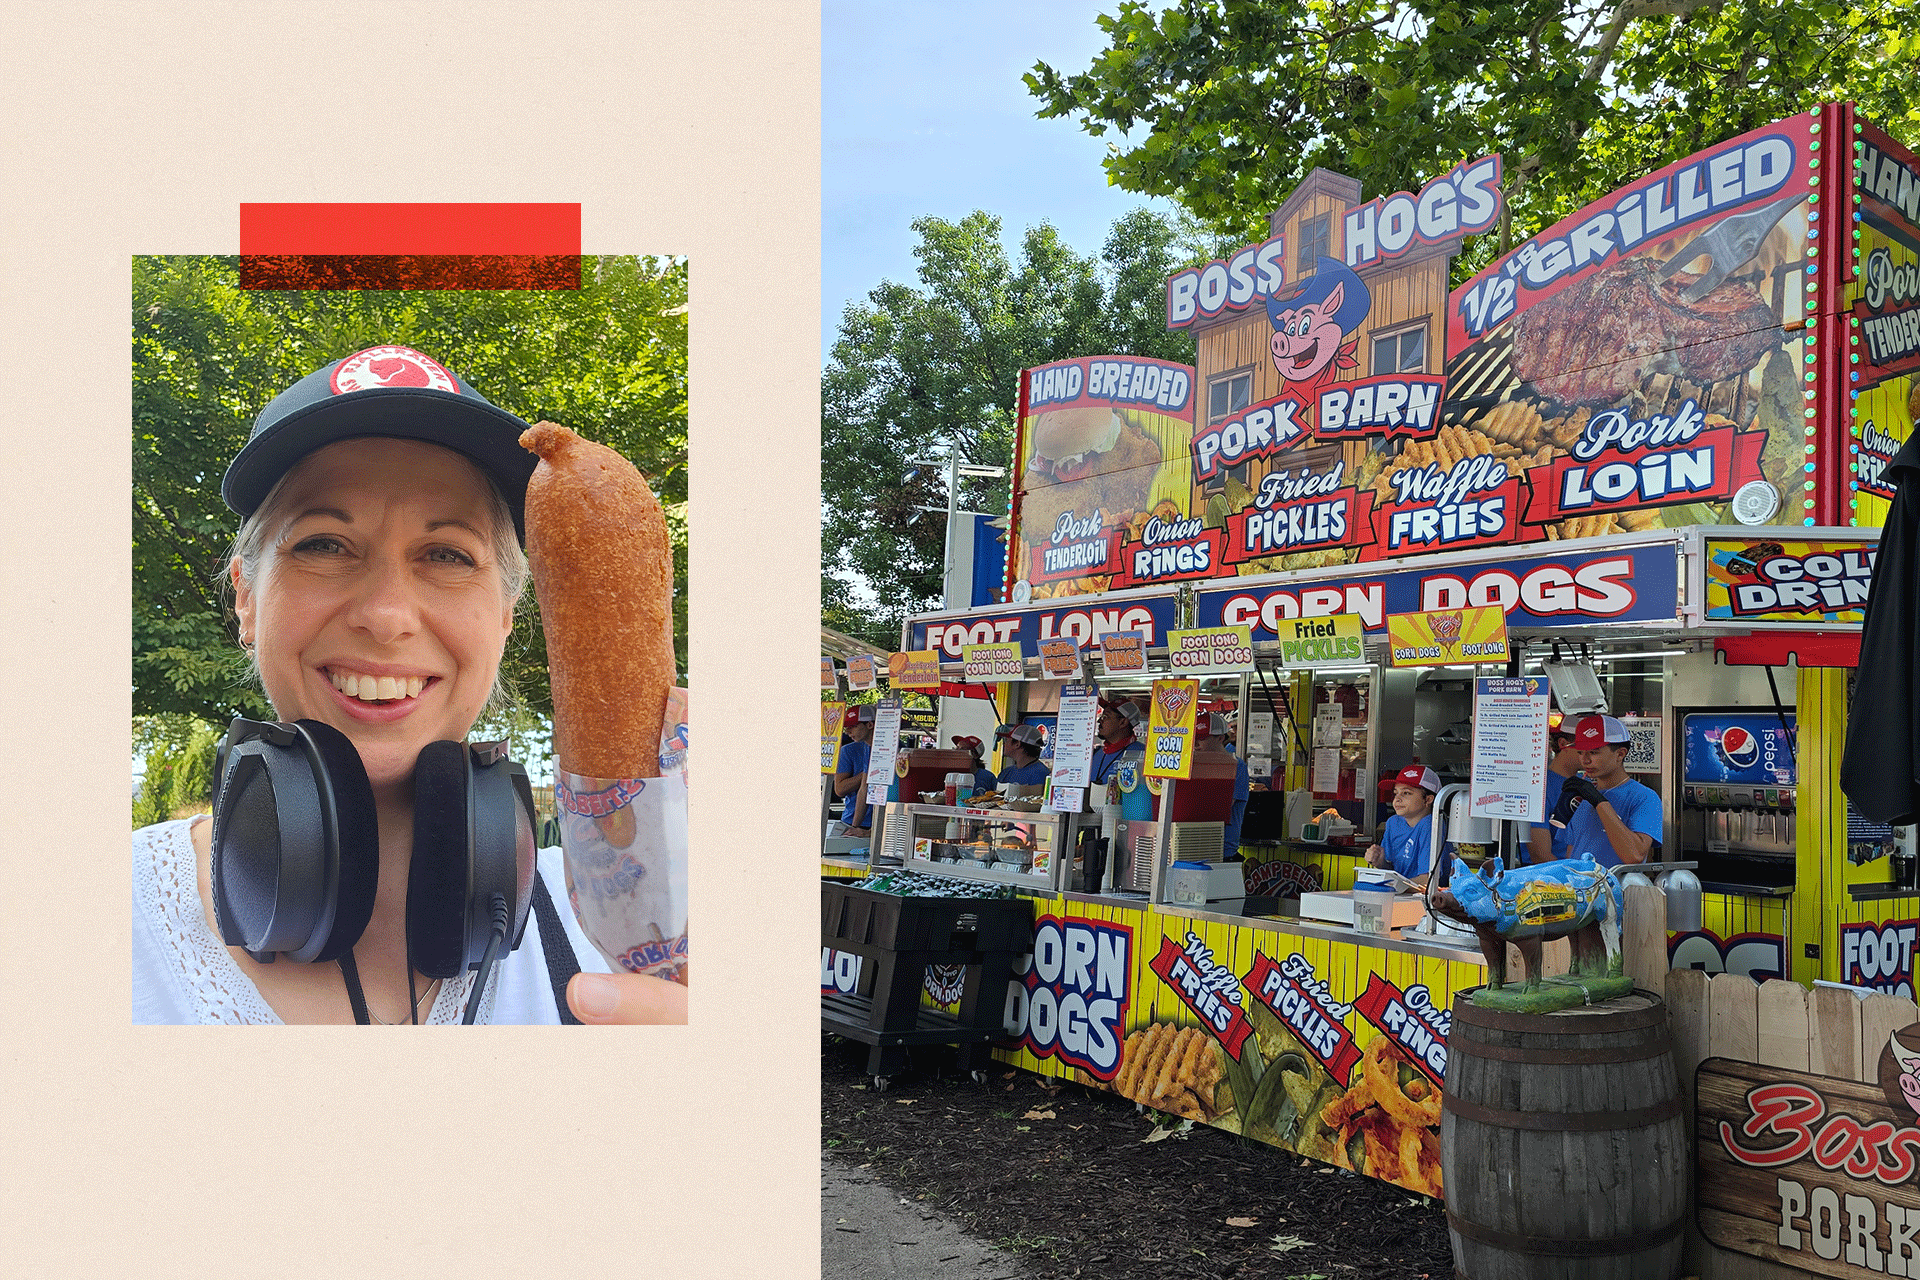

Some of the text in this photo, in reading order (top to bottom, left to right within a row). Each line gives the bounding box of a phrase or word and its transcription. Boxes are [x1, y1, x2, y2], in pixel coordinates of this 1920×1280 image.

[1526, 139, 1790, 283] GRILLED
[1171, 161, 1497, 322] BOSS HOG'S
[1030, 362, 1189, 408] HAND BREADED
[1198, 381, 1438, 473] PORK BARN
[1572, 398, 1704, 461] Pork
[1255, 461, 1344, 509] Fried
[1392, 456, 1508, 505] Waffle
[1051, 509, 1103, 543] Pork
[1143, 512, 1203, 546] Onion
[1223, 561, 1636, 632] CORN DOGS
[926, 606, 1154, 656] FOOT LONG
[1105, 634, 1137, 649] Onion
[1181, 633, 1239, 649] FOOT LONG
[1295, 618, 1336, 639] Fried
[971, 649, 1012, 660] FOOT LONG
[1041, 642, 1075, 657] Waffle
[1043, 656, 1079, 671] FRIES
[1104, 649, 1144, 667] RINGS
[1171, 647, 1251, 667] CORN DOGS
[1283, 637, 1360, 662] PICKLES
[1395, 647, 1440, 659] CORN DOGS
[1462, 642, 1505, 655] FOOT LONG
[898, 671, 939, 684] Tenderloin
[965, 661, 1022, 676] CORN DOGS
[1156, 736, 1183, 752] CORN
[1761, 728, 1778, 772] pepsi
[1153, 754, 1180, 770] DOGS
[1184, 932, 1243, 1005] Waffle
[1844, 927, 1916, 981] FOOT
[925, 976, 942, 1001] ORN
[1280, 953, 1352, 1021] Fried
[1003, 980, 1118, 1069] DOGS
[1719, 1083, 1920, 1185] Boss
[1776, 1177, 1920, 1280] PORK
